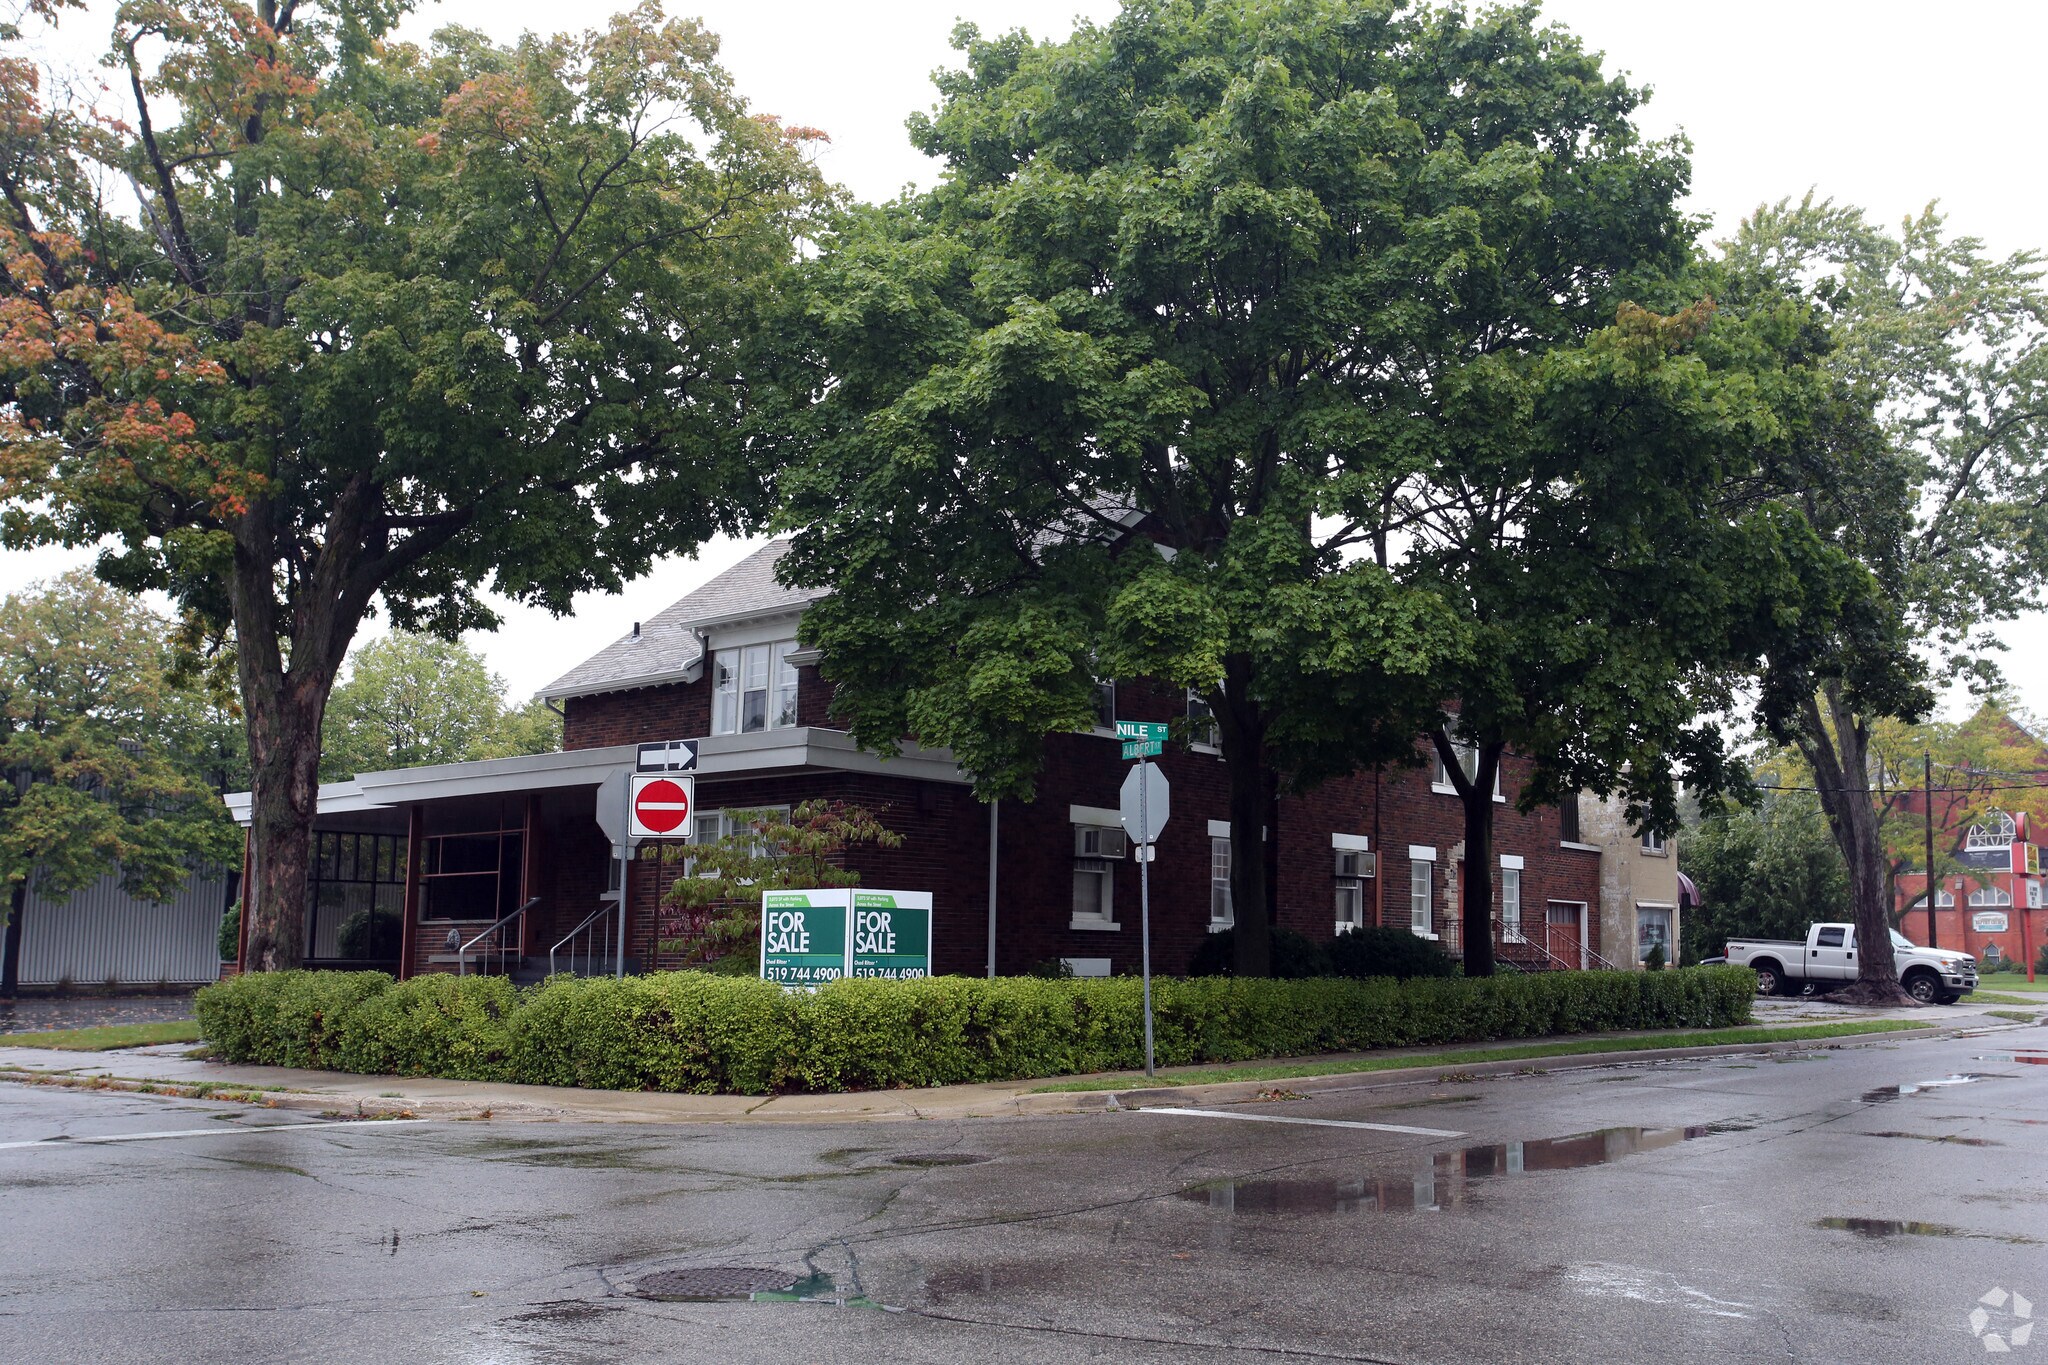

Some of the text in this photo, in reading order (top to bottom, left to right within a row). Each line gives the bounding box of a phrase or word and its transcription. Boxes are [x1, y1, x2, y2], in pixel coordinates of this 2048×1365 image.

[1117, 723, 1167, 737] NILE ST
[1123, 740, 1155, 756] ALBERT
[768, 911, 805, 933] FOR
[856, 911, 892, 933] FOR
[767, 931, 810, 953] SALE
[855, 932, 896, 953] SALE
[767, 967, 841, 981] 519 744 4900
[855, 967, 925, 980] 519 744 4900
